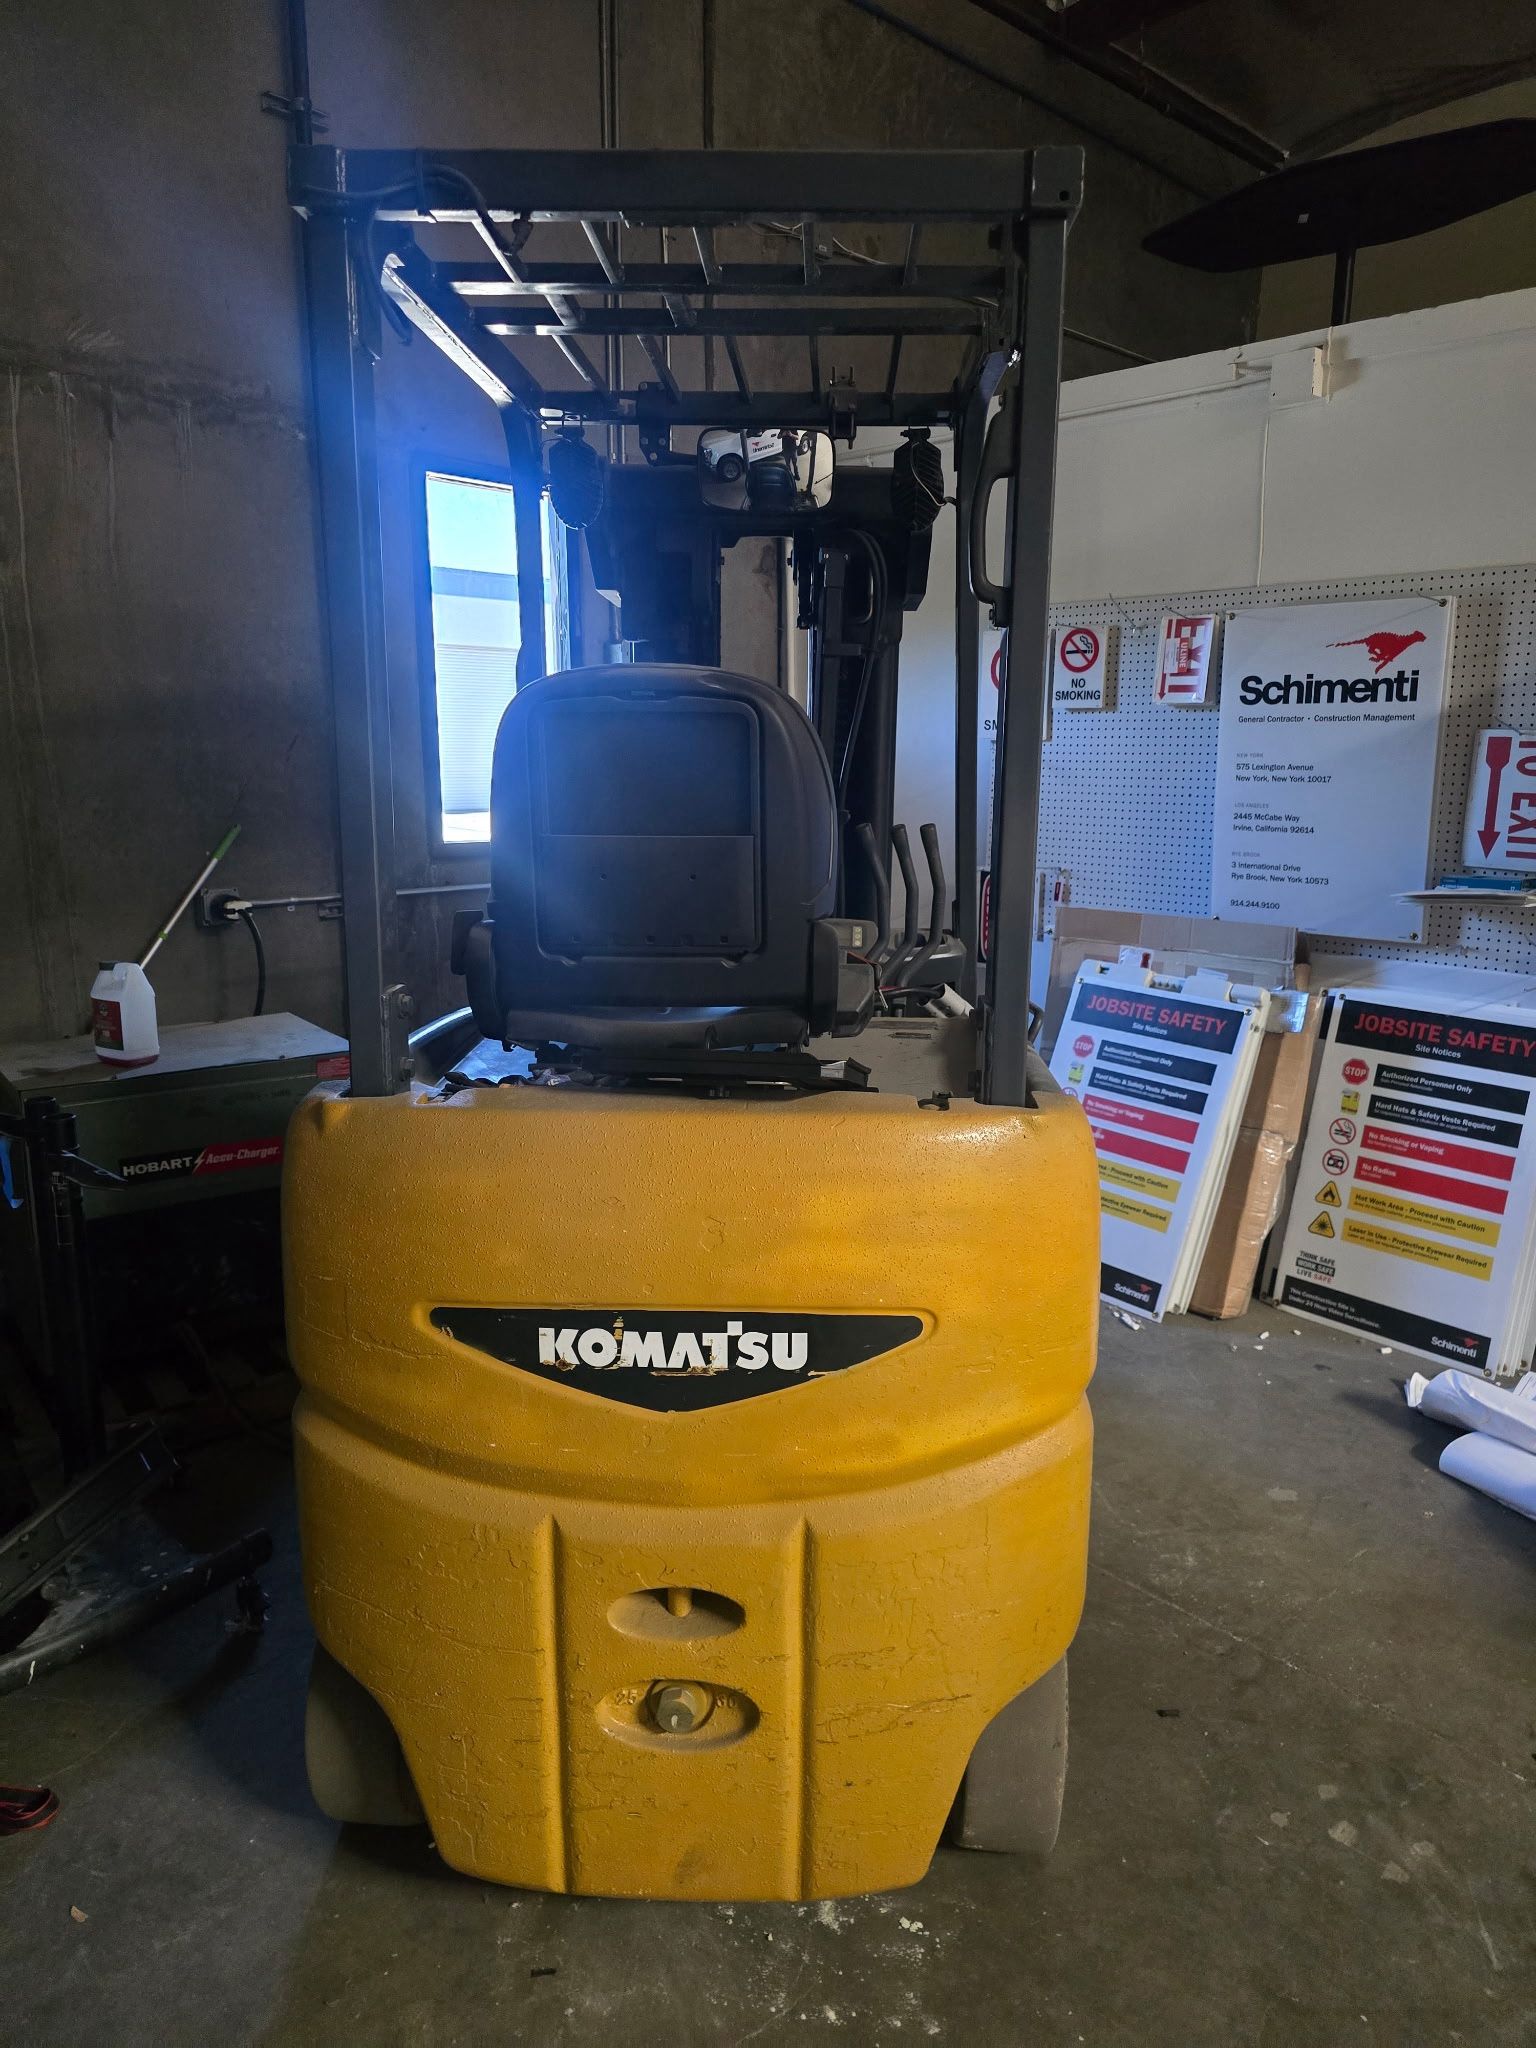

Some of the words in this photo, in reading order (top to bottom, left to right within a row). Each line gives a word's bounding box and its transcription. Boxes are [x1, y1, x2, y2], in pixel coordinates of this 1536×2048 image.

[1178, 639, 1187, 669] ULINE
[1071, 678, 1086, 688] NO
[1240, 670, 1420, 706] Schimenti
[1055, 690, 1100, 701] SMOKING
[1314, 714, 1361, 722] Construction
[1363, 714, 1416, 723] Management
[1252, 763, 1286, 772] Lexington
[1236, 774, 1250, 782] New
[1252, 774, 1270, 783] York,
[1233, 812, 1252, 820] 2445
[1254, 813, 1282, 822] McCabe
[1284, 814, 1300, 823] Way
[1233, 824, 1253, 832] Irvine,
[1290, 826, 1314, 834] 92614
[1238, 862, 1281, 871] International
[1282, 864, 1300, 872] Drive
[1232, 872, 1244, 880] Rye
[1246, 873, 1268, 882] Brook,
[1287, 876, 1302, 884] York
[1305, 877, 1329, 886] 10573
[1230, 899, 1280, 910] 914.244.9100
[1087, 995, 1156, 1021] JOBSITE
[1158, 1008, 1228, 1036] SAFETY
[1132, 1022, 1144, 1031] Site
[1146, 1024, 1168, 1036] Notices
[1354, 1013, 1443, 1043] JOBSITE
[1447, 1028, 1536, 1058] SAFETY
[1075, 1041, 1092, 1050] STOP
[1416, 1044, 1430, 1054] Site
[1432, 1046, 1462, 1059] Notices
[1160, 1056, 1173, 1067] Only
[1344, 1066, 1367, 1077] STOP
[1382, 1070, 1419, 1083] Authorized
[1420, 1078, 1454, 1091] Personnel
[1456, 1084, 1472, 1094] Only
[1161, 1088, 1188, 1100] Required
[1376, 1102, 1392, 1110] Hard
[1392, 1105, 1408, 1114] Hats
[1410, 1108, 1416, 1116] &
[1418, 1109, 1440, 1121] Safety
[1442, 1114, 1462, 1124] Vests
[1462, 1119, 1496, 1132] Required
[1368, 1132, 1378, 1140] No
[1380, 1134, 1410, 1148] Smoking
[1420, 1143, 1444, 1156] Vaping
[206, 1146, 279, 1165] Accu-Charger
[123, 1156, 193, 1176] HOBART
[1362, 1163, 1372, 1172] No
[1372, 1166, 1396, 1176] Radios
[1111, 1167, 1132, 1178] Proceed
[1134, 1174, 1145, 1182] with
[1146, 1178, 1168, 1189] Caution
[1142, 1208, 1166, 1222] Required
[1355, 1194, 1368, 1202] Hot
[1369, 1196, 1386, 1206] Work
[1388, 1202, 1404, 1211] Area
[1409, 1207, 1438, 1220] Proceed
[1440, 1216, 1455, 1226] with
[1456, 1220, 1486, 1233] Caution
[1349, 1226, 1366, 1236] Laser
[1375, 1232, 1387, 1241] Use
[1392, 1237, 1424, 1251] Protective
[1426, 1246, 1454, 1259] Eyewear
[1456, 1254, 1488, 1269] Required
[1300, 1250, 1318, 1260] THINK
[1319, 1256, 1336, 1266] SAFE
[1297, 1259, 1316, 1270] WORK
[1317, 1265, 1334, 1276] SAFE
[1296, 1268, 1312, 1278] LIVE
[1313, 1272, 1332, 1284] SAFE
[1114, 1282, 1150, 1302] Schimenti
[1290, 1287, 1300, 1295] This
[538, 1320, 808, 1370] KOMATSU
[1430, 1336, 1477, 1358] Schimenti
